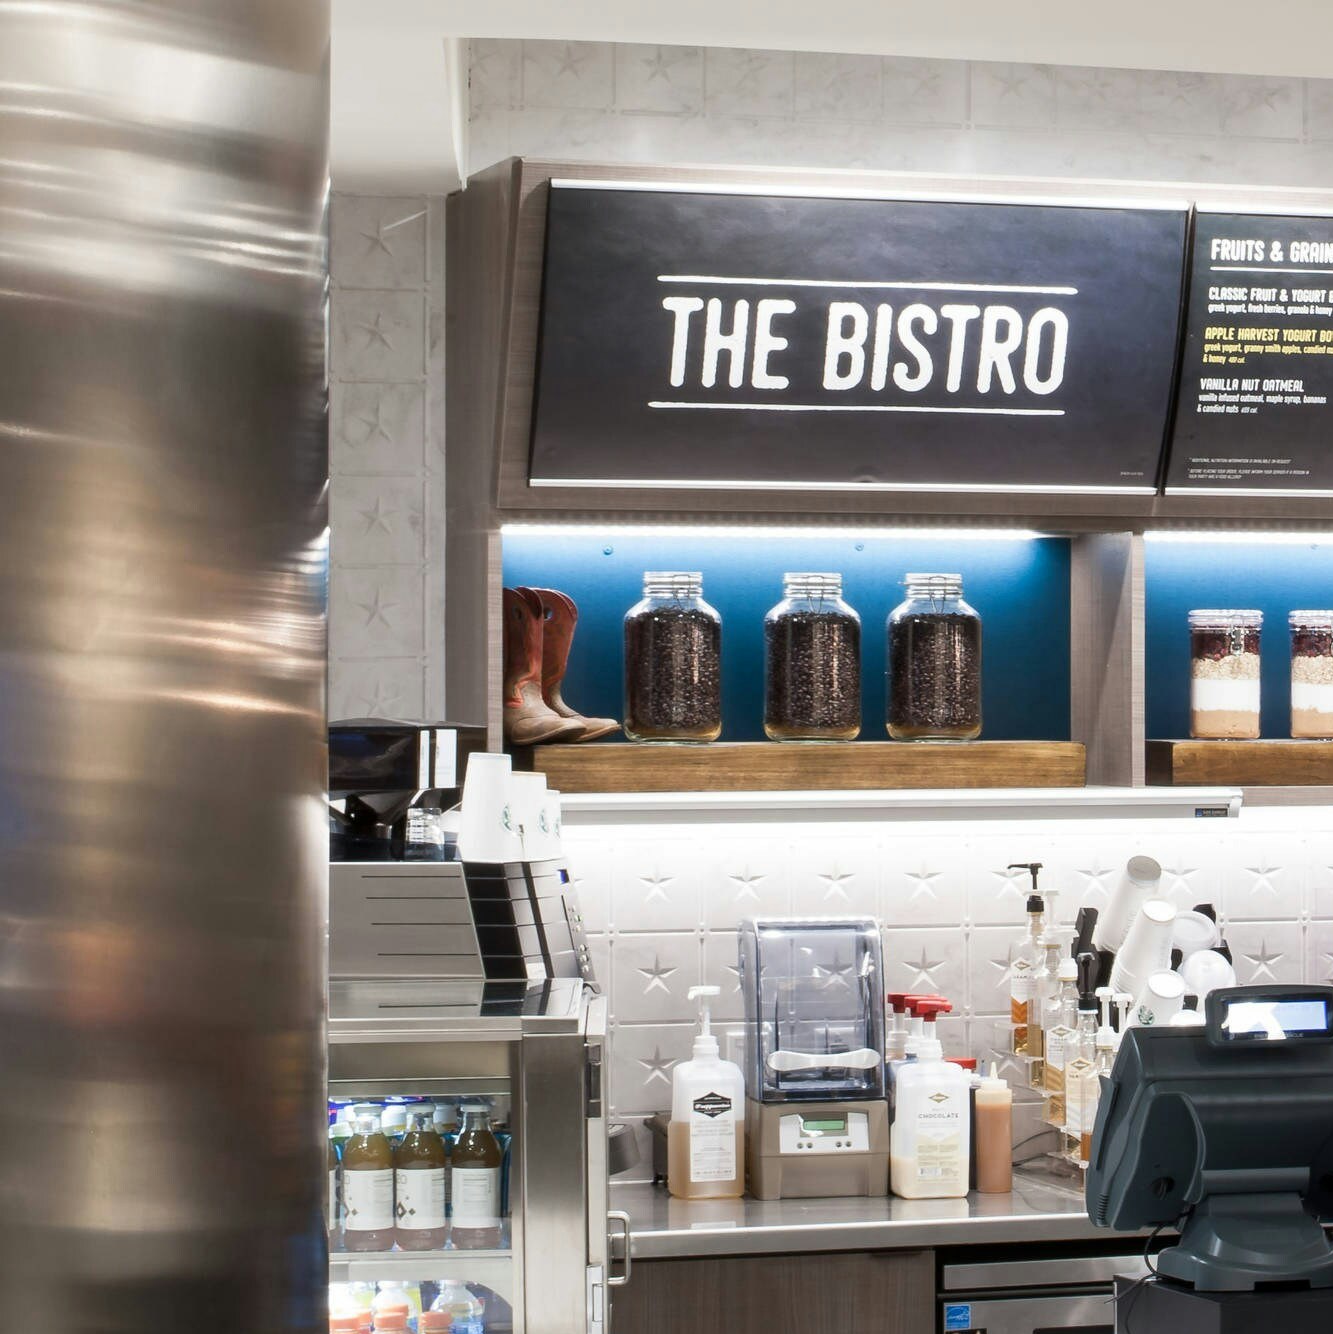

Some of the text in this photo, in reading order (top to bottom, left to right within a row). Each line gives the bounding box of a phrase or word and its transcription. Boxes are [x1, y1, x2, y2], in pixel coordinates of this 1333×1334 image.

[1211, 239, 1265, 261] FRUITS
[1270, 241, 1283, 262] &
[1209, 287, 1247, 300] CLASSIC
[1251, 288, 1277, 301] FRUIT
[1280, 289, 1288, 302] &
[1292, 289, 1326, 303] YOGURT
[1205, 327, 1234, 340] APPLE
[1238, 328, 1279, 341] HARVEST
[1283, 330, 1317, 342] YOGURT
[662, 297, 1068, 394] THE BISTRO
[1201, 378, 1238, 390] VANILLA
[1242, 379, 1259, 391] NUT
[1263, 379, 1304, 392] OATMEAL
